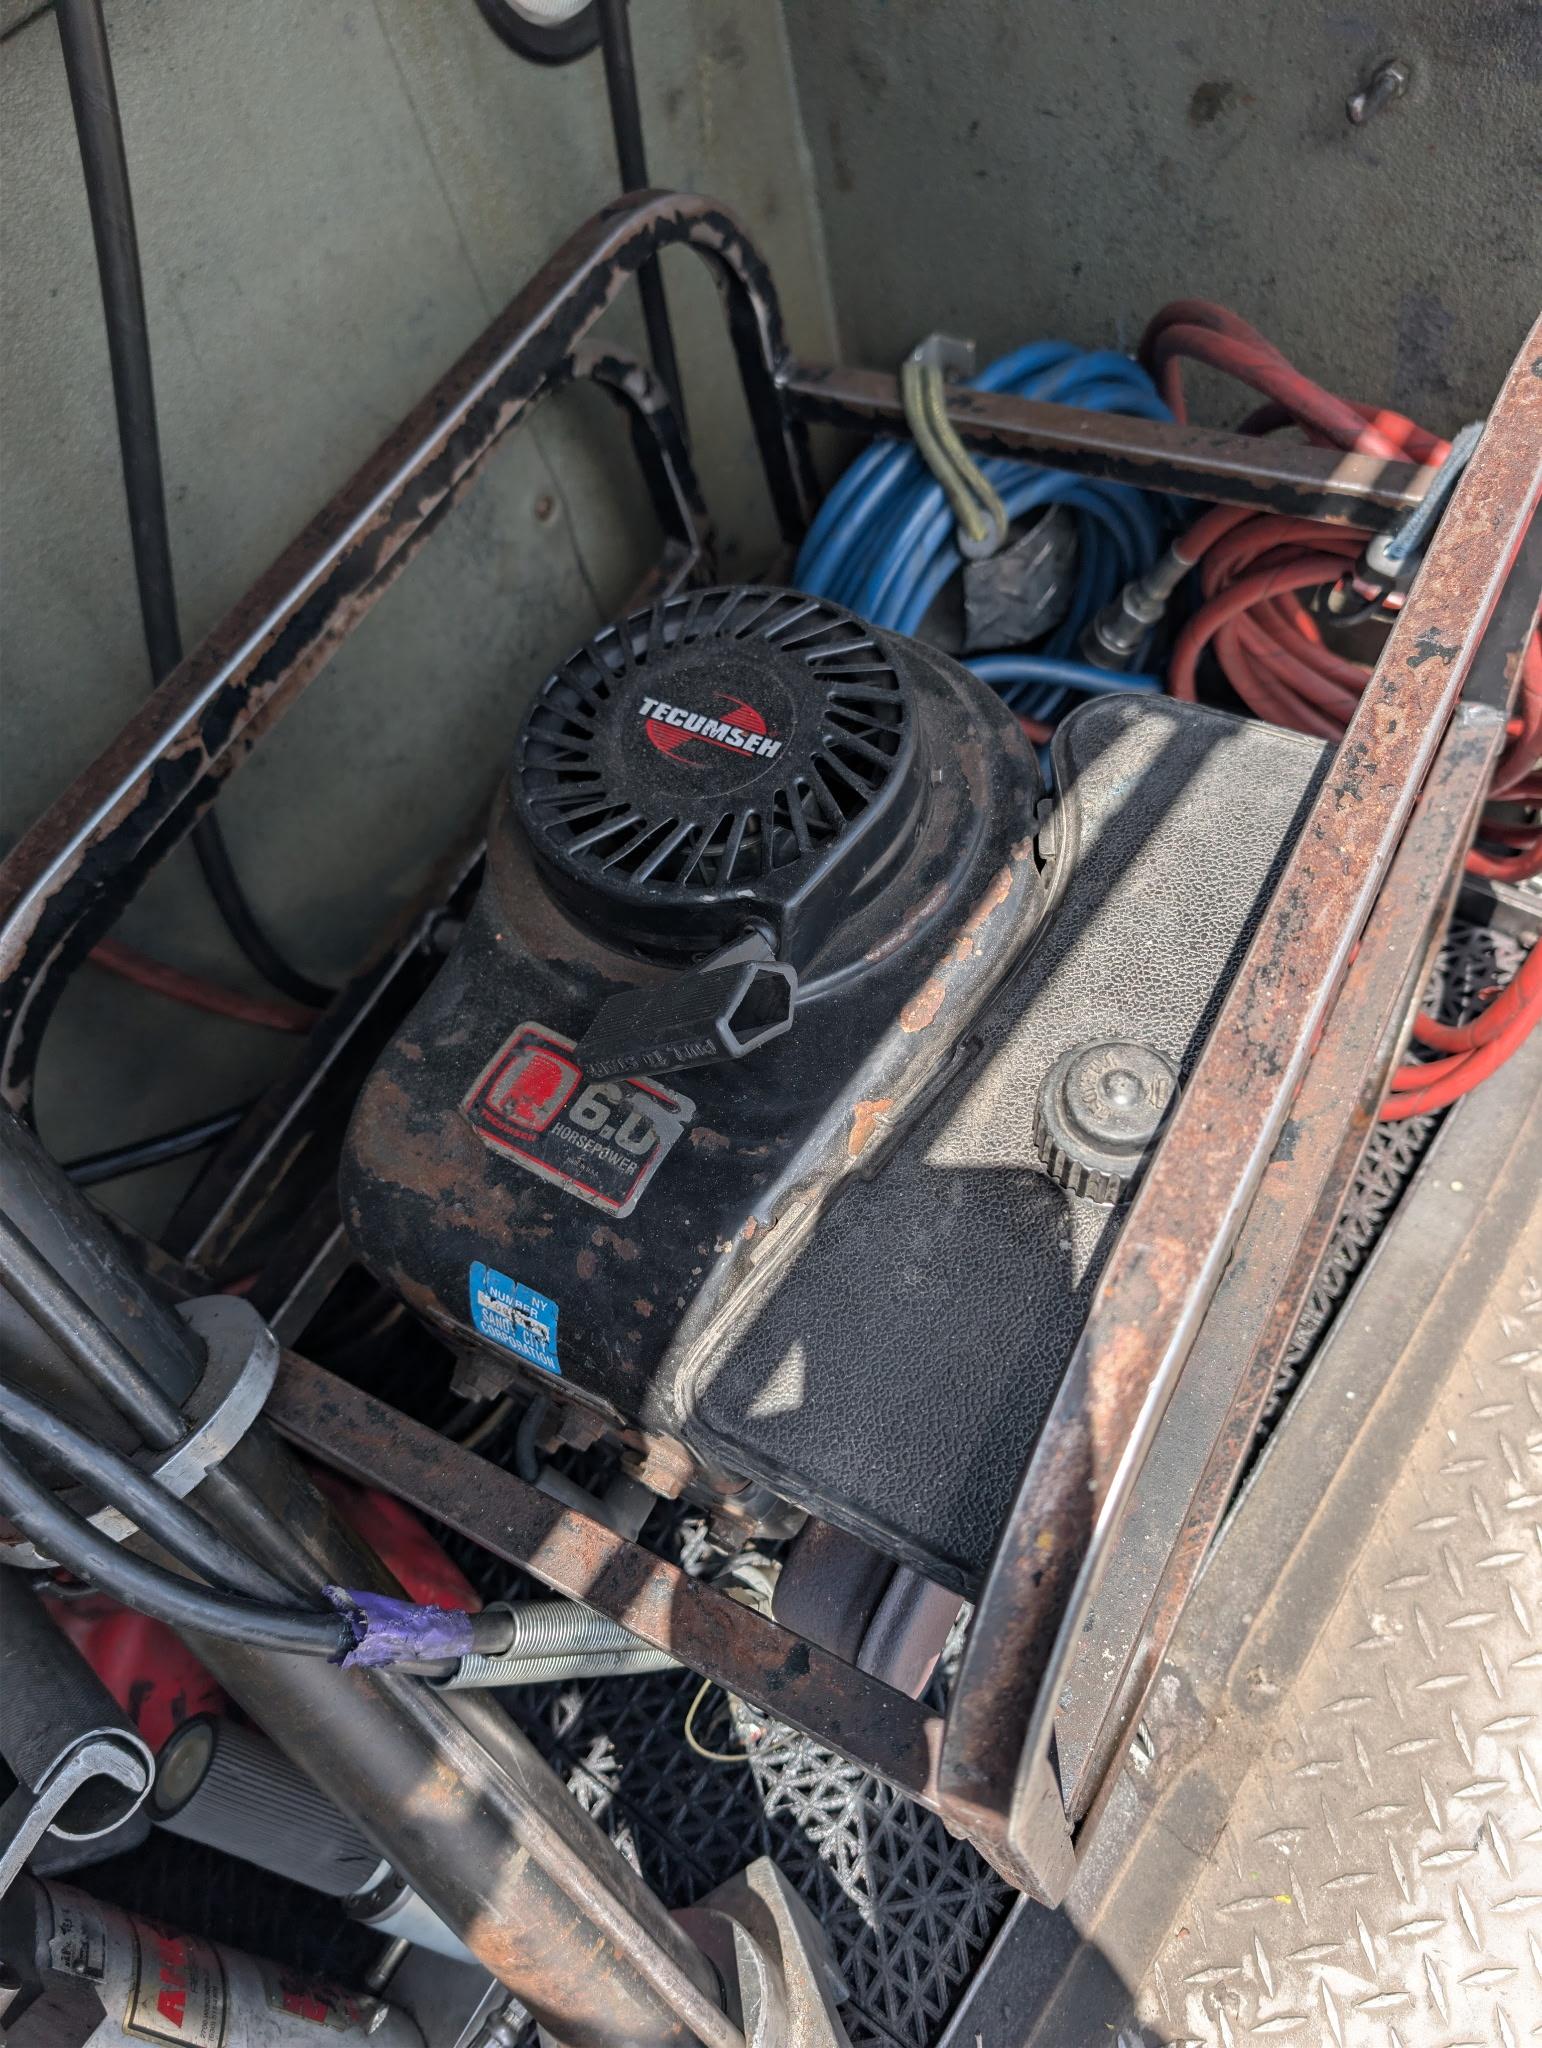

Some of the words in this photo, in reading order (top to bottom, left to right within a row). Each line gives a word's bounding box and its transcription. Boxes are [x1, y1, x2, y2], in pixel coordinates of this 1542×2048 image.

[638, 697, 782, 758] TECUMSEH
[569, 1083, 659, 1155] 6.0
[551, 1121, 638, 1176] HORSEPOWER
[531, 1296, 548, 1312] NY
[480, 1320, 556, 1370] CORPORATION
[522, 1329, 547, 1353] CITY
